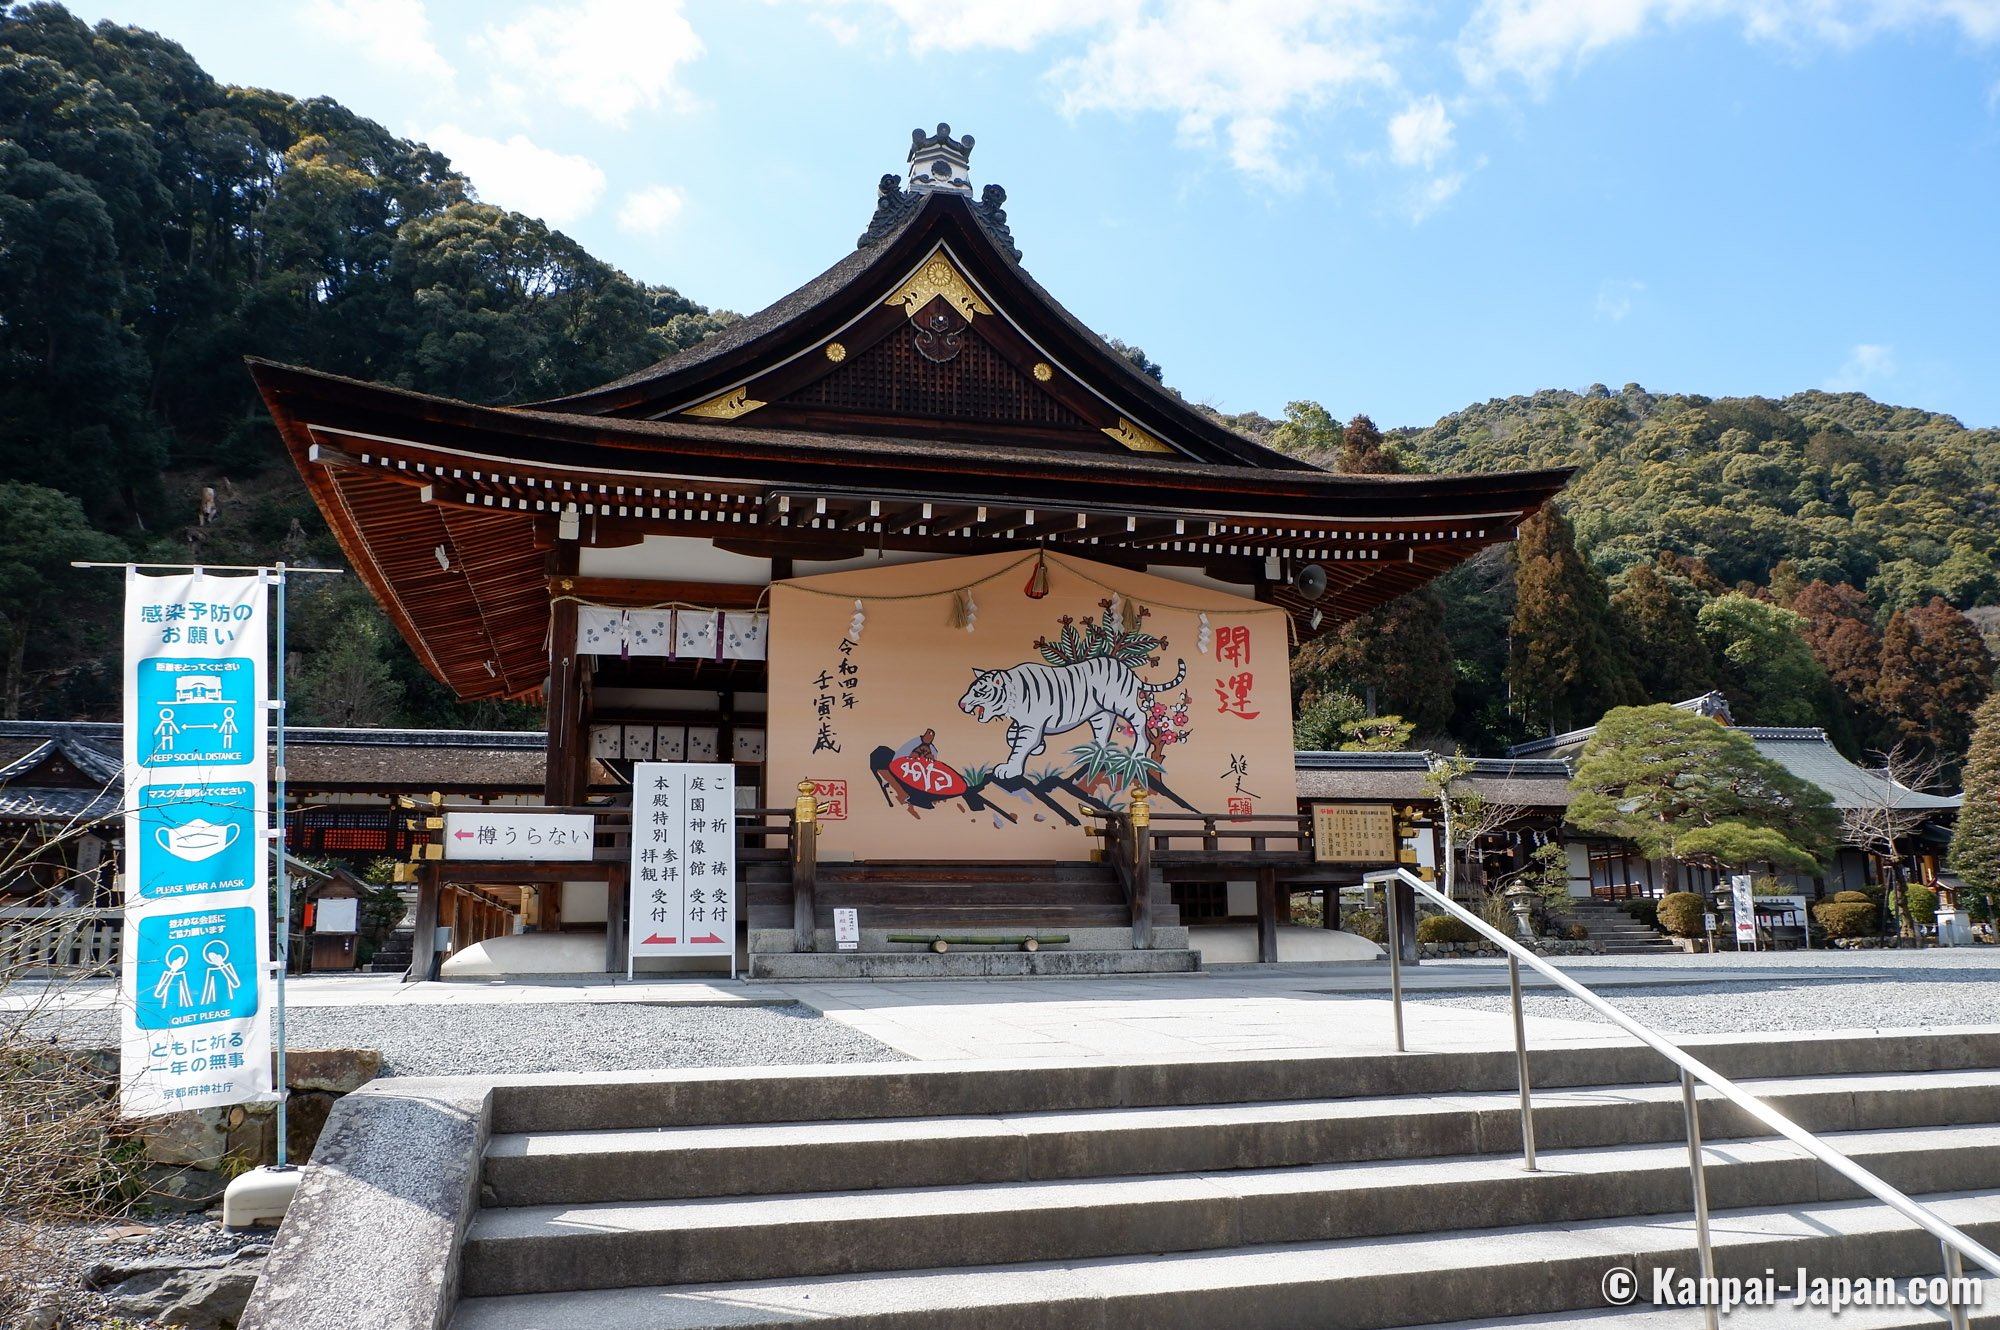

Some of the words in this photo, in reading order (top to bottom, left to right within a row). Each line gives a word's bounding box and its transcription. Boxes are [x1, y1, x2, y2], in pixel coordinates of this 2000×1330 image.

[141, 602, 253, 623] 感染予防の
[162, 626, 234, 645] お願い
[156, 662, 240, 672] 距離をとってください
[838, 638, 859, 709] 令和四年
[1215, 625, 1260, 720] 開運
[151, 754, 172, 762] KEEP
[174, 753, 204, 761] SOCIAL
[206, 752, 242, 760] DISTANCE
[653, 776, 670, 843] 本殿特別
[477, 825, 589, 845] 樽うらない
[688, 776, 706, 923] 庭園神像館受付
[640, 848, 658, 882] 拝観
[661, 849, 679, 882] 参拝
[155, 884, 183, 895] PLEASE
[185, 882, 208, 892] WEAR
[219, 879, 245, 888] MASK
[650, 888, 667, 923] 受付
[171, 1013, 198, 1025] QUIET
[199, 1009, 231, 1021] PLEASE
[151, 1032, 244, 1058] ともに祈る
[150, 1052, 245, 1076] 一年の無事
[163, 1082, 234, 1100] 京都府神社庁
